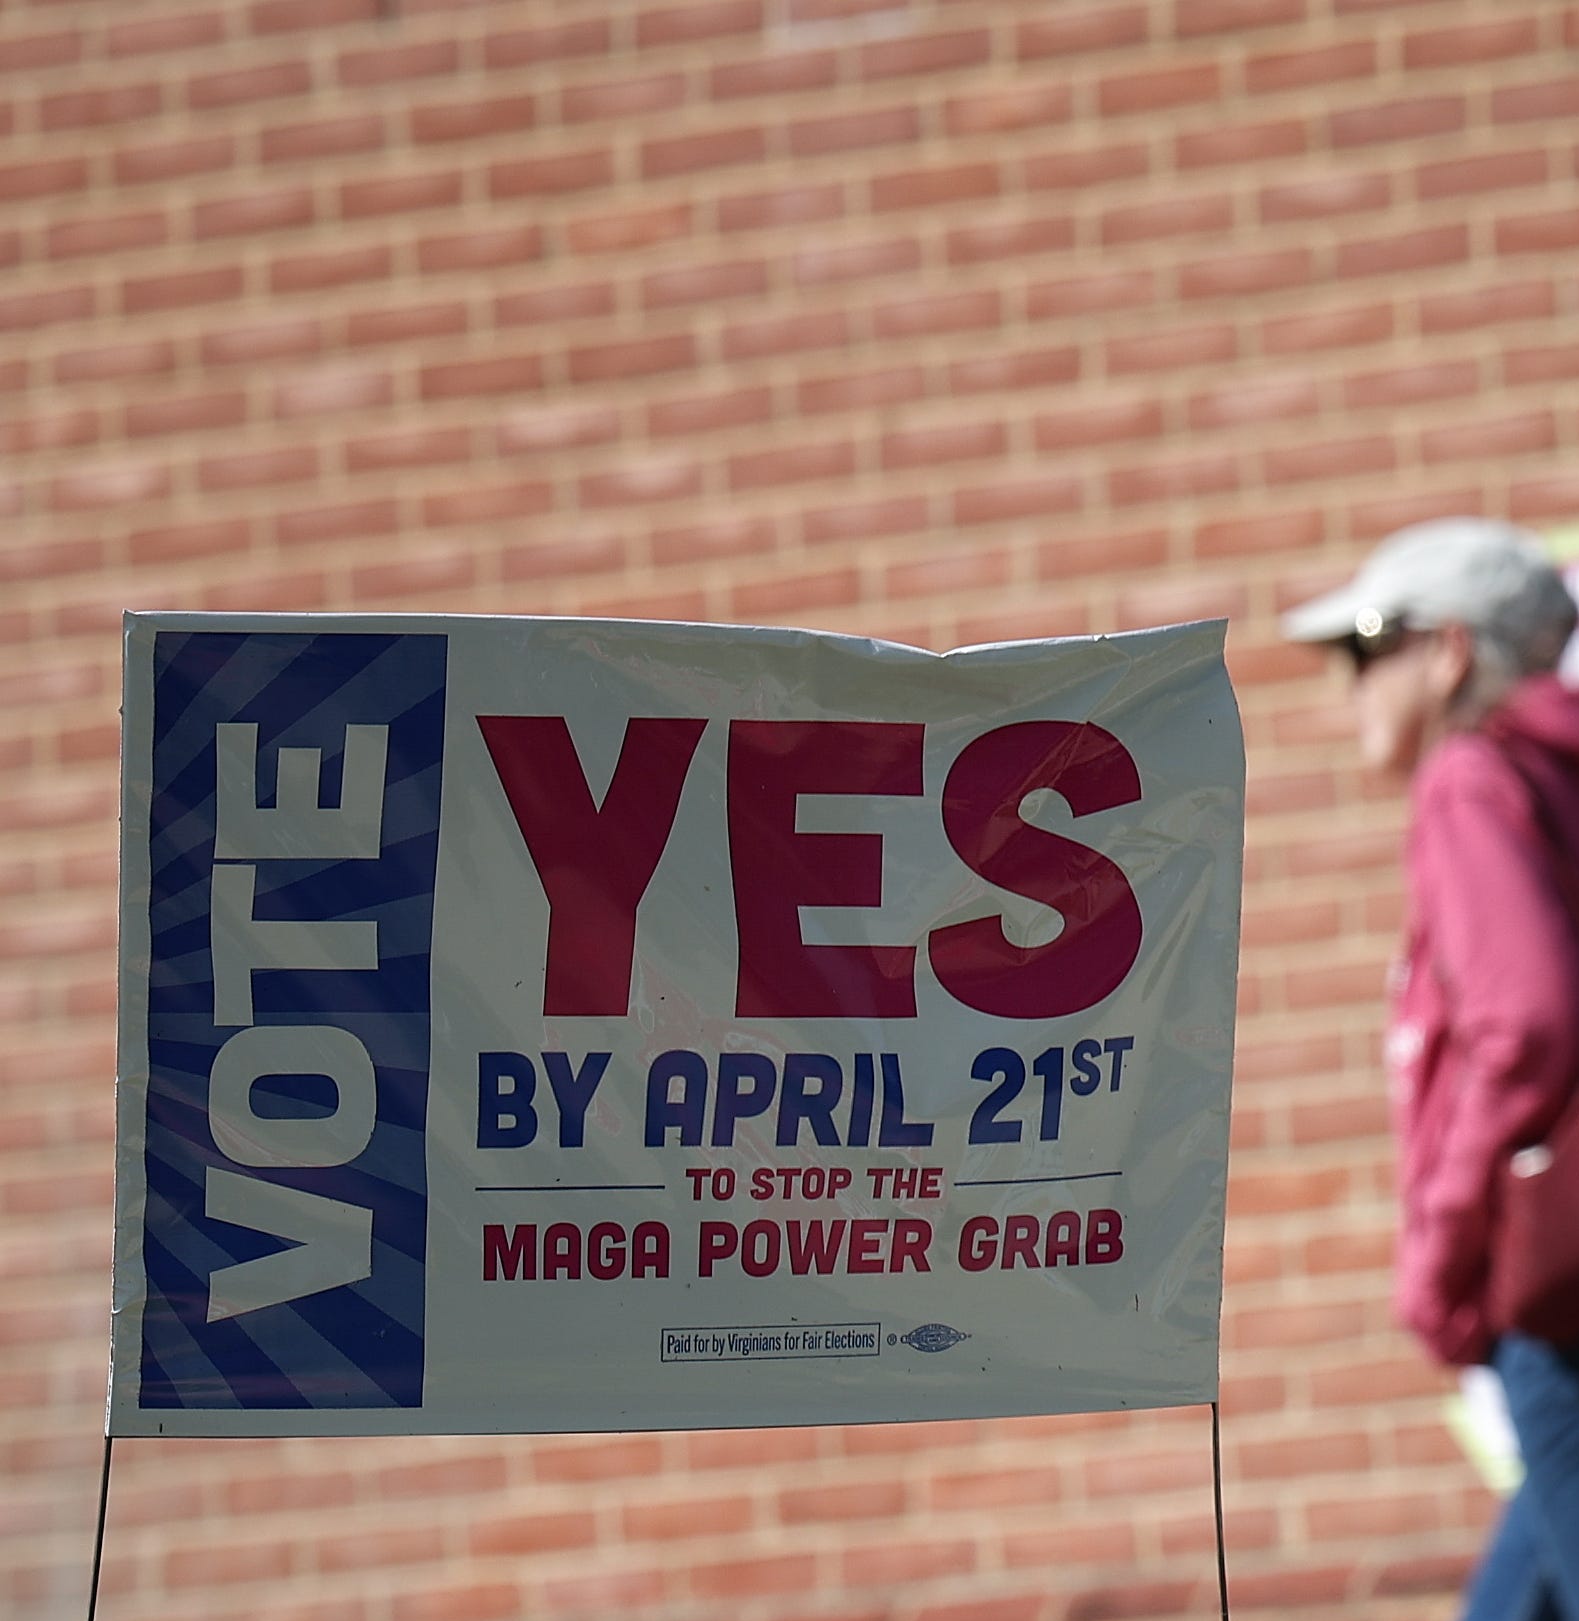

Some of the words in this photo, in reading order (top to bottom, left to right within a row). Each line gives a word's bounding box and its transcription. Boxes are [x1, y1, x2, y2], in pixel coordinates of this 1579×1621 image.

[475, 715, 1143, 1019] YES
[205, 722, 389, 1323] VOTE
[476, 1052, 612, 1148] BY
[644, 1049, 935, 1147] APRIL
[968, 1036, 1134, 1145] 21ST
[685, 1168, 736, 1200] TO
[750, 1167, 852, 1199] STOP
[865, 1166, 942, 1198] THE
[483, 1222, 670, 1281] MAGA
[698, 1218, 932, 1278] POWER
[957, 1208, 1124, 1272] GRAB
[667, 1334, 691, 1353] Paid
[693, 1333, 709, 1352] for
[712, 1333, 725, 1356] by
[728, 1332, 781, 1355] Virginians
[784, 1331, 800, 1350] for
[802, 1331, 821, 1350] Fair
[824, 1329, 875, 1349] Elections
